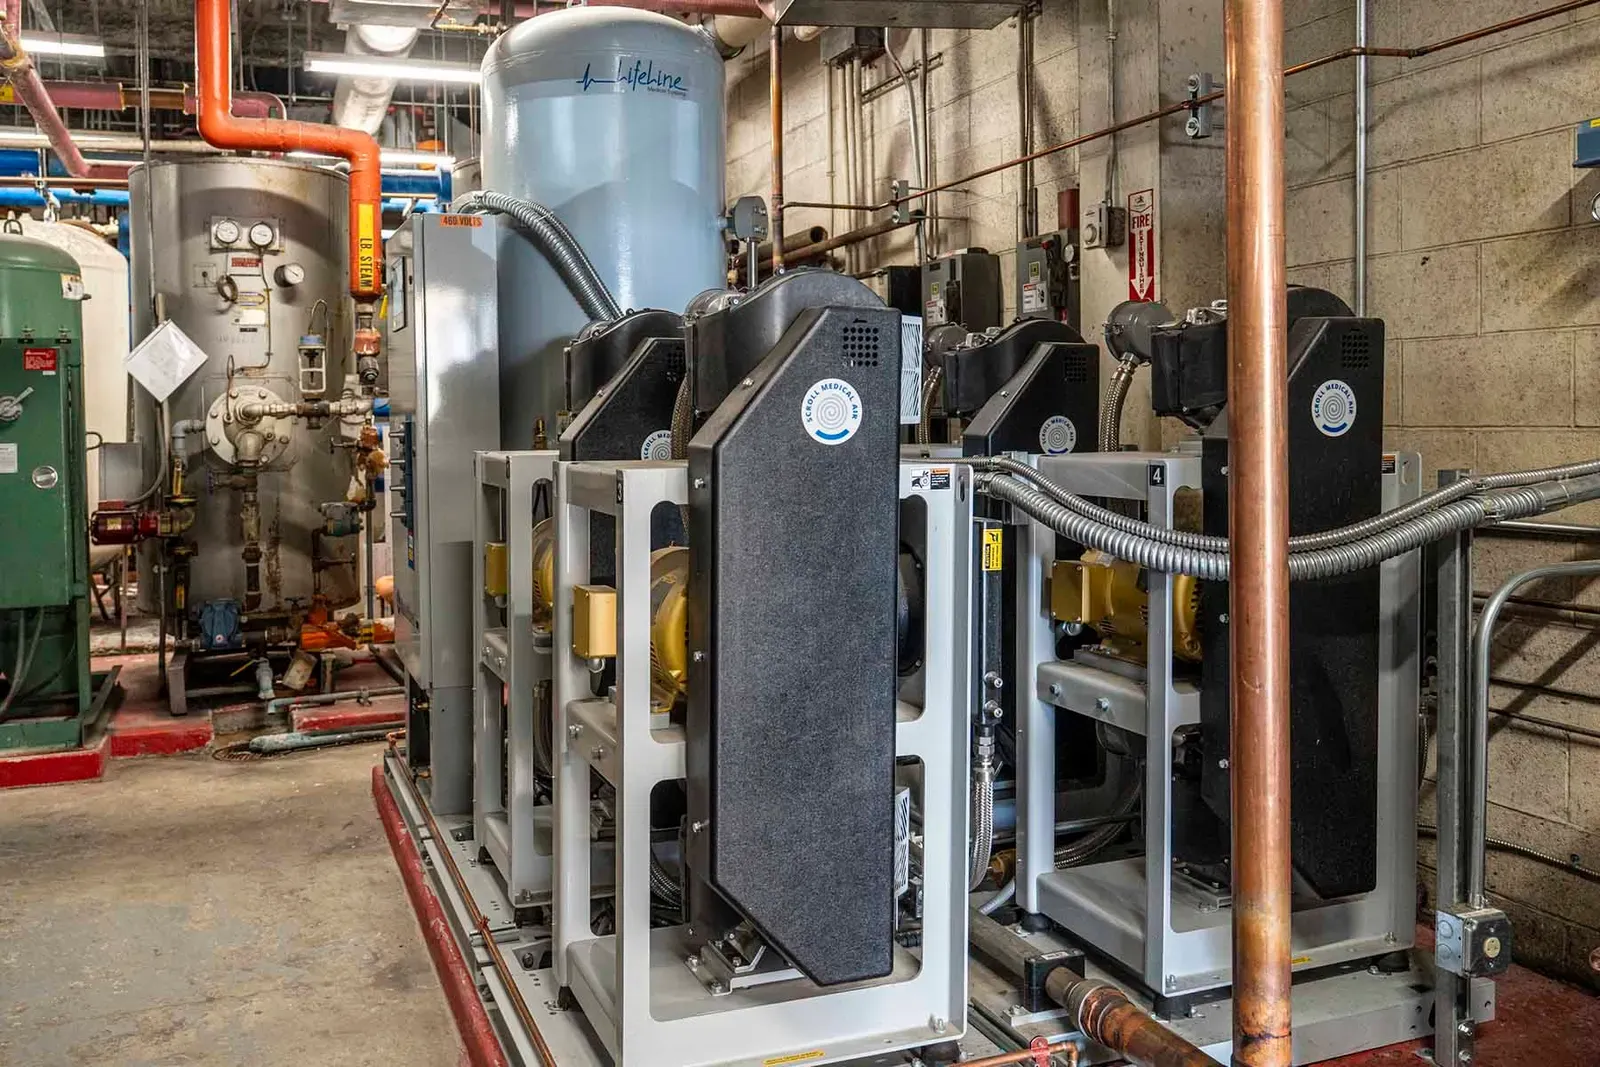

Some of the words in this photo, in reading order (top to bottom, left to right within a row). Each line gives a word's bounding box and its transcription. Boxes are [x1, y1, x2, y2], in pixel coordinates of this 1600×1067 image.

[617, 60, 689, 91] LifeLine
[459, 215, 483, 227] VOLTS
[1132, 213, 1149, 229] FIRE
[360, 237, 373, 252] LB.
[360, 255, 373, 288] STEAM
[805, 390, 820, 423] SCROLL
[820, 383, 855, 402] MEDICAL
[851, 404, 859, 420] AIR
[1314, 390, 1325, 418] SCROLL
[1325, 383, 1351, 399] MEDICAL
[1152, 467, 1162, 483] 4
